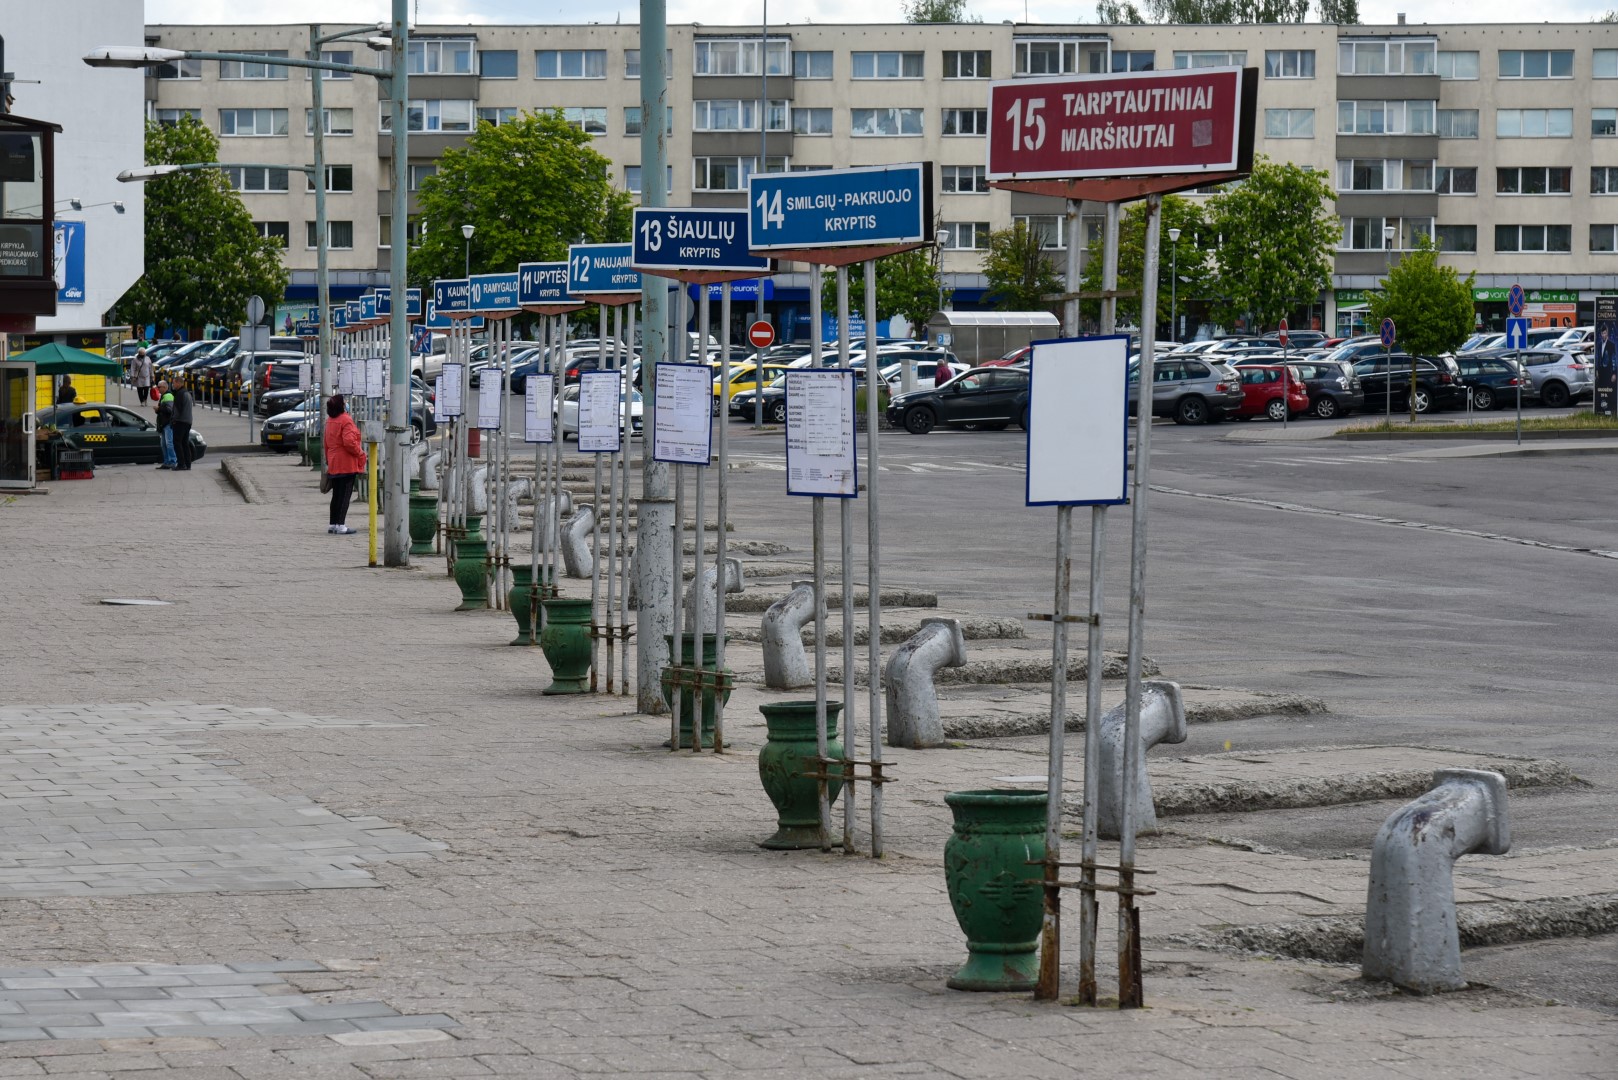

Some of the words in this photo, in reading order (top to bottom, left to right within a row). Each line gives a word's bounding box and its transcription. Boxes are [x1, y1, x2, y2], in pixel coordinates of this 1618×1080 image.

[1006, 98, 1046, 151] 15
[1062, 86, 1214, 116] TARPTAUTINIAI
[1061, 121, 1175, 152] MARŠRUTAI
[756, 189, 785, 230] 14
[825, 215, 877, 231] KRYPTIS
[640, 219, 662, 251] 13
[667, 215, 735, 244] ŠIAULIŲ
[679, 246, 720, 258] KRYPTIS
[572, 255, 590, 282] 12
[594, 256, 632, 269] NAUJAMI
[522, 271, 532, 294] 11
[534, 267, 567, 284] UPYTĖS
[611, 274, 638, 284] KRYPTIS
[437, 287, 443, 306] 9
[447, 285, 469, 297] KAUNO
[471, 283, 481, 303] 10
[483, 281, 518, 294] RAMYGALO
[494, 296, 511, 304] KRYPTIS
[539, 288, 560, 297] KRYPTIS
[361, 301, 367, 314] 6
[377, 294, 383, 308] 7
[310, 310, 315, 321] 2
[335, 312, 340, 324] 4
[347, 306, 352, 318] 5
[429, 305, 436, 321] 8
